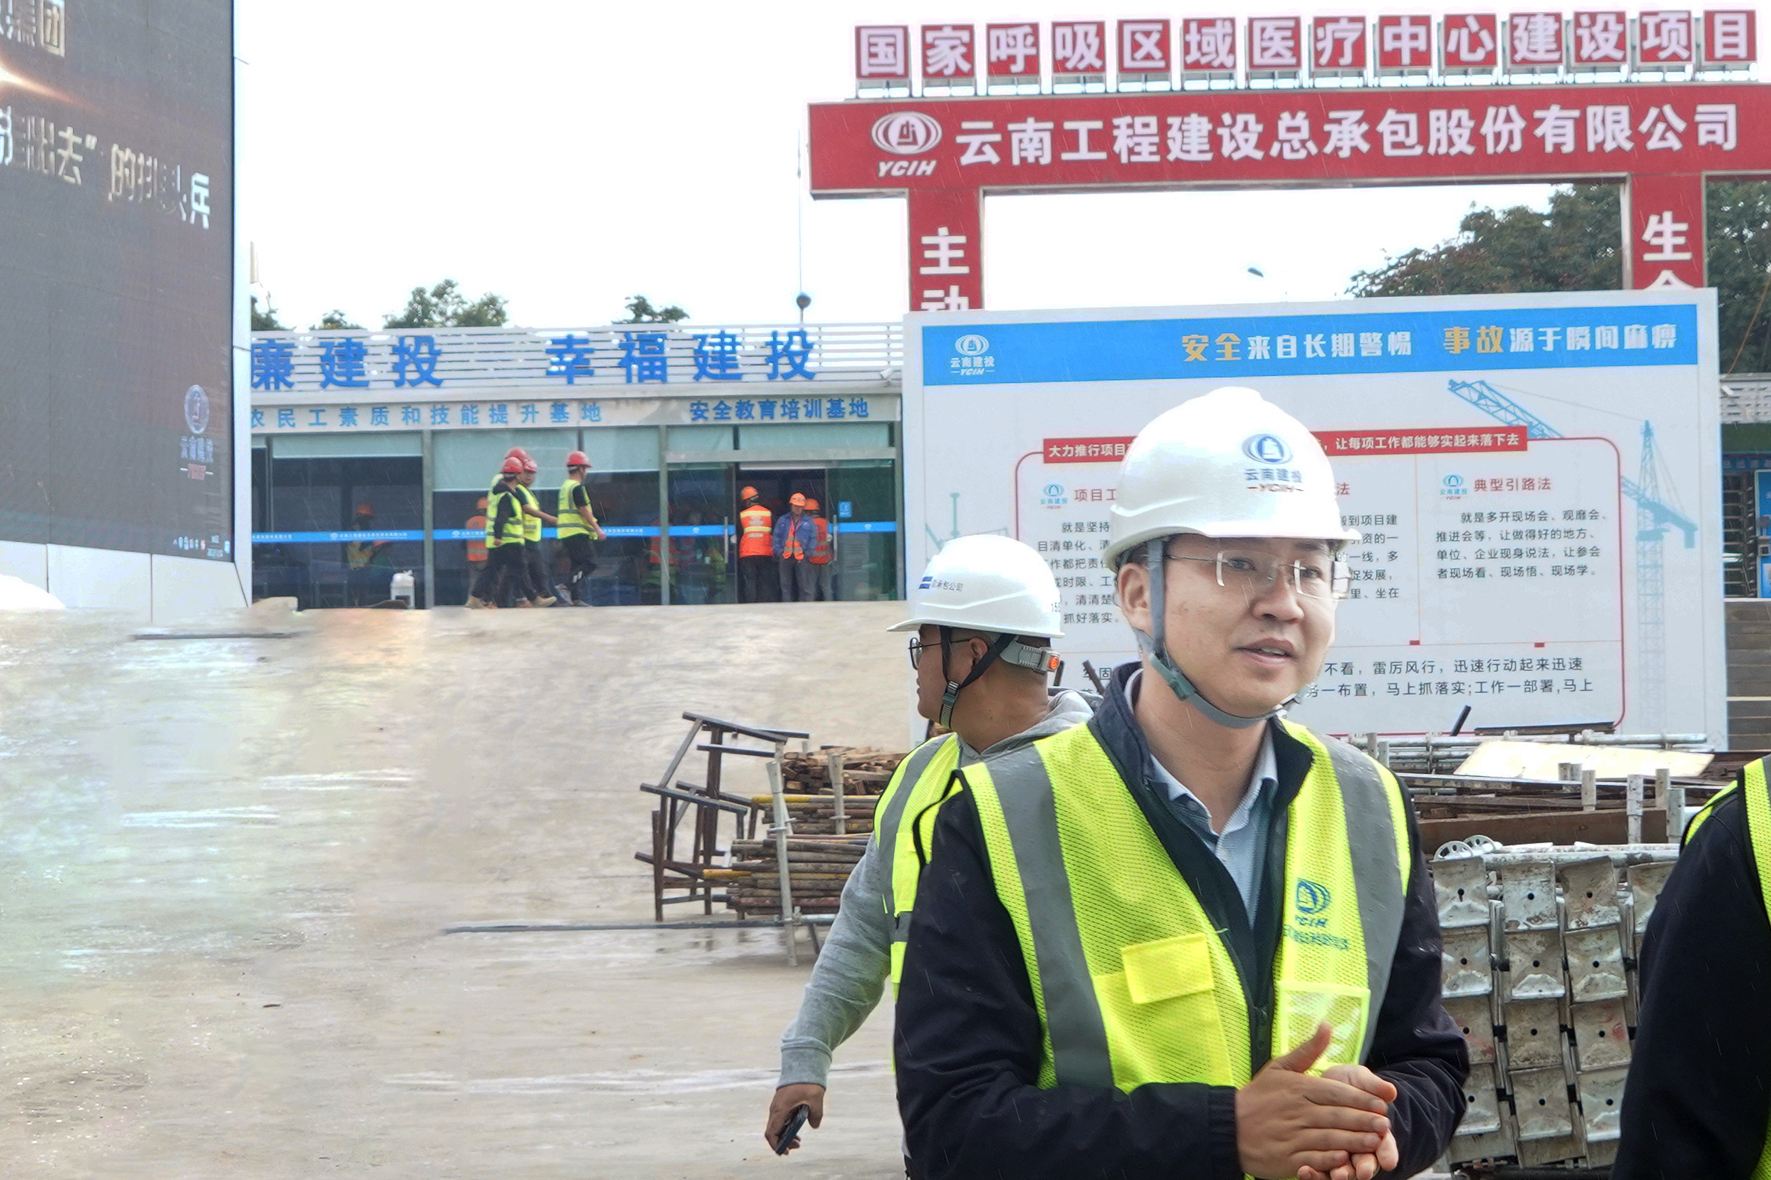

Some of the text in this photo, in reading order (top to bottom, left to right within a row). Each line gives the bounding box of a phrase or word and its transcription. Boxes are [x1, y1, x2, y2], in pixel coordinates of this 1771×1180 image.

[859, 11, 1750, 77] 国家呼吸区域医疗中心建设项目
[955, 103, 1738, 167] 云南工程建设总承包股份有限公司
[877, 160, 937, 177] YCIH
[1443, 323, 1677, 354] 事故源于瞬间麻痹
[545, 329, 818, 385] 幸福建投
[950, 356, 995, 368] 云南建投
[960, 368, 985, 376] YCIH
[251, 403, 602, 429] 农民工素质和技能提升基地
[690, 398, 870, 422] 安全教育培训基地
[1317, 433, 1520, 451] ，让每项工作都能够实起来落下去
[1049, 444, 1131, 458] 大力推行项目
[1473, 477, 1552, 493] 典型引路法
[1061, 521, 1110, 534] 就是坚持
[1044, 557, 1109, 570] 作都把责
[1060, 594, 1113, 606] ，清清楚
